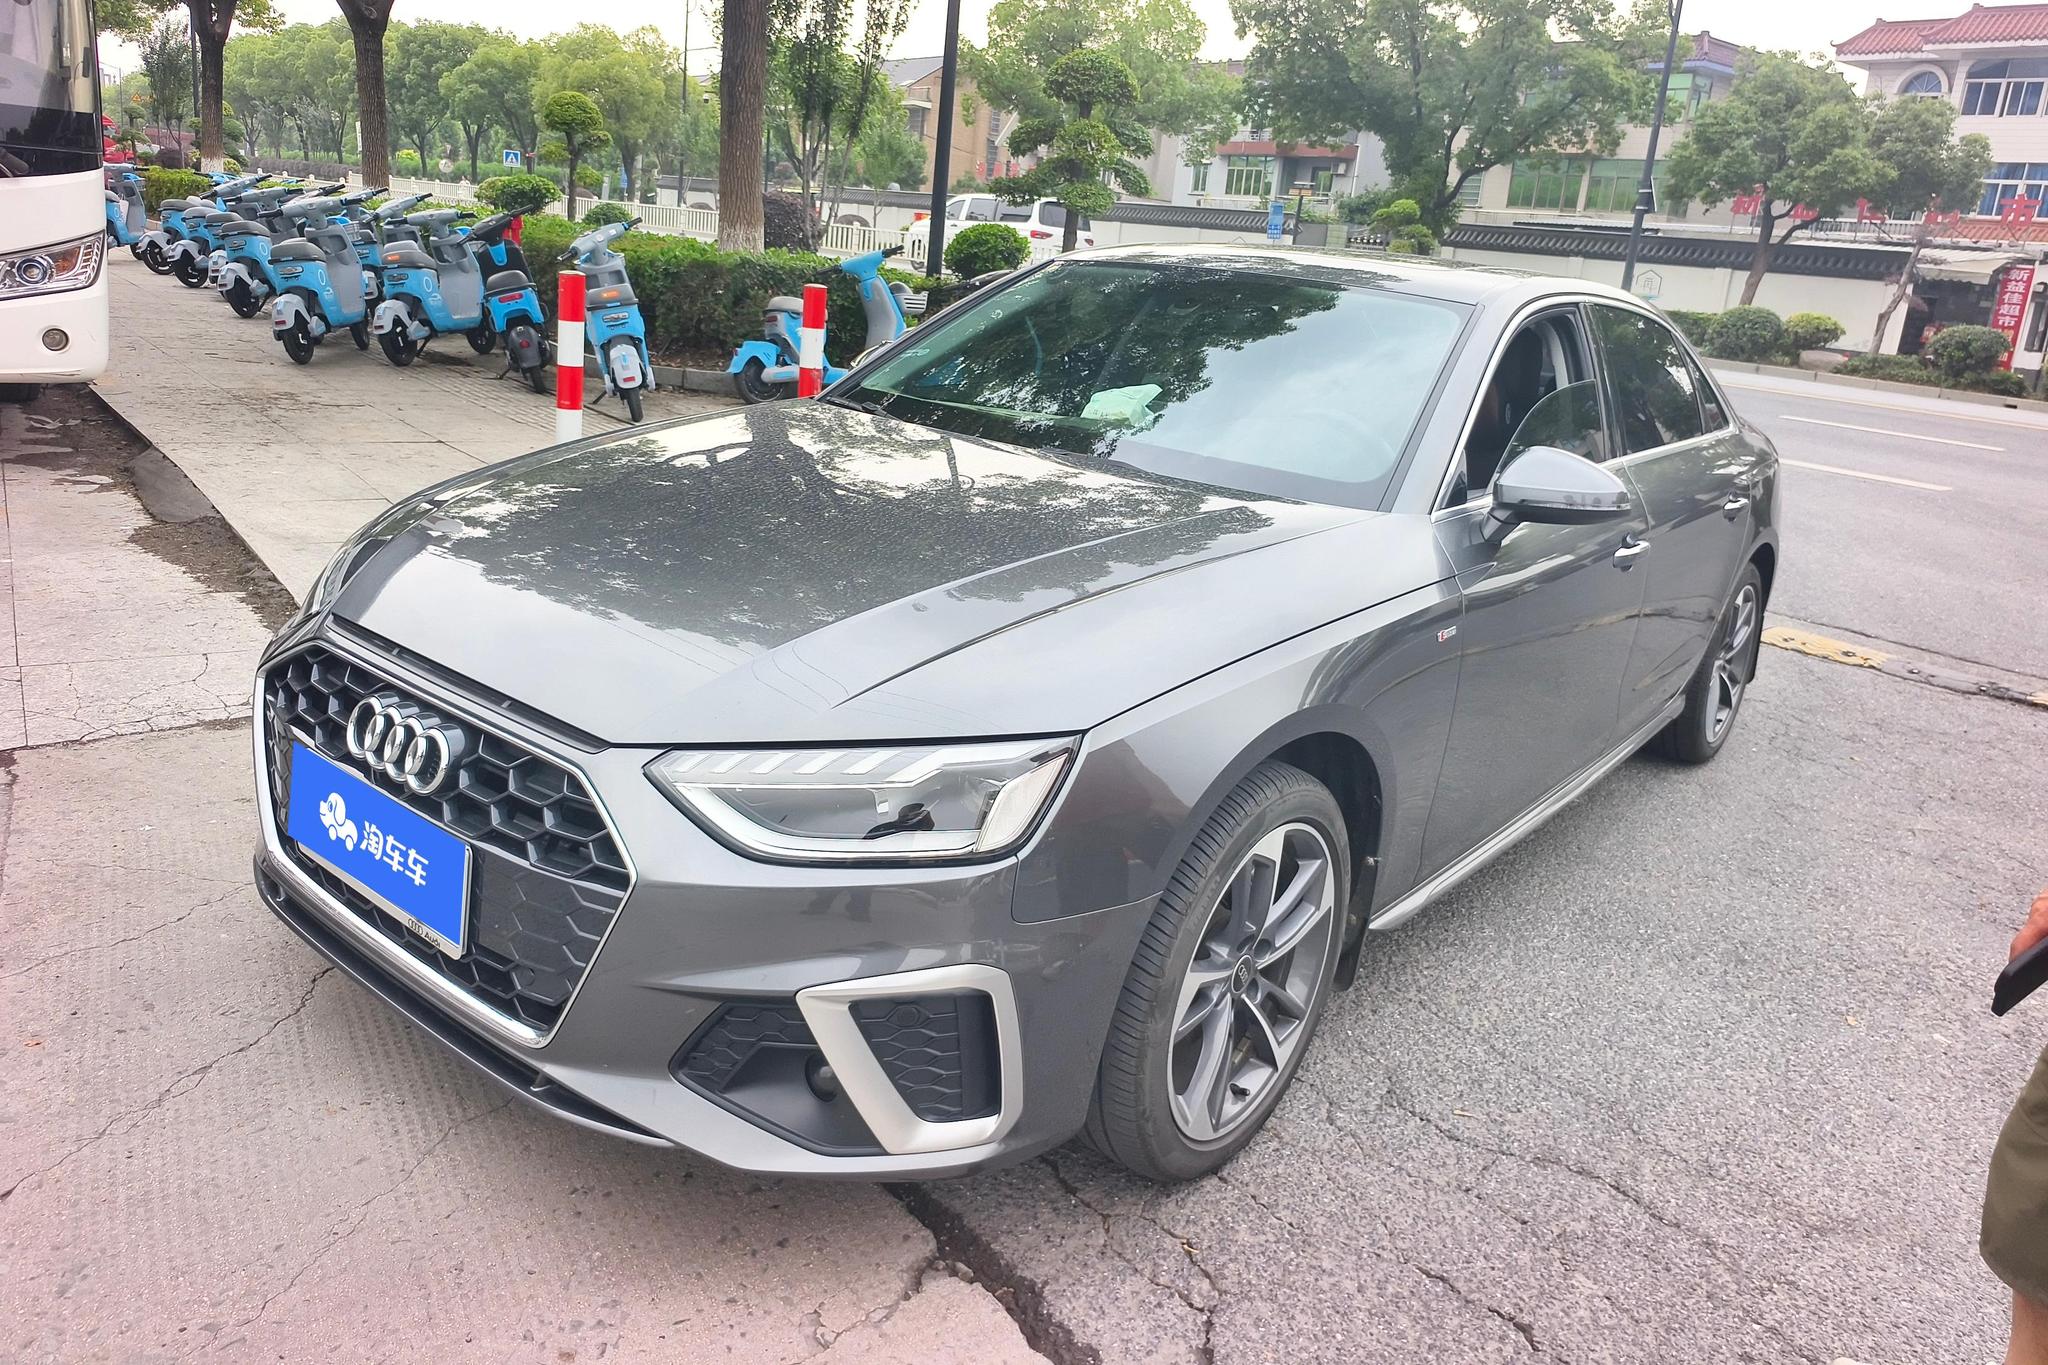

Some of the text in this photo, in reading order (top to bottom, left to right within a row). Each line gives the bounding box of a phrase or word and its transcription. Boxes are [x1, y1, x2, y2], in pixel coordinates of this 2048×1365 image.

[1998, 269, 2030, 327] 新益佳超市
[424, 931, 441, 948] Audi
